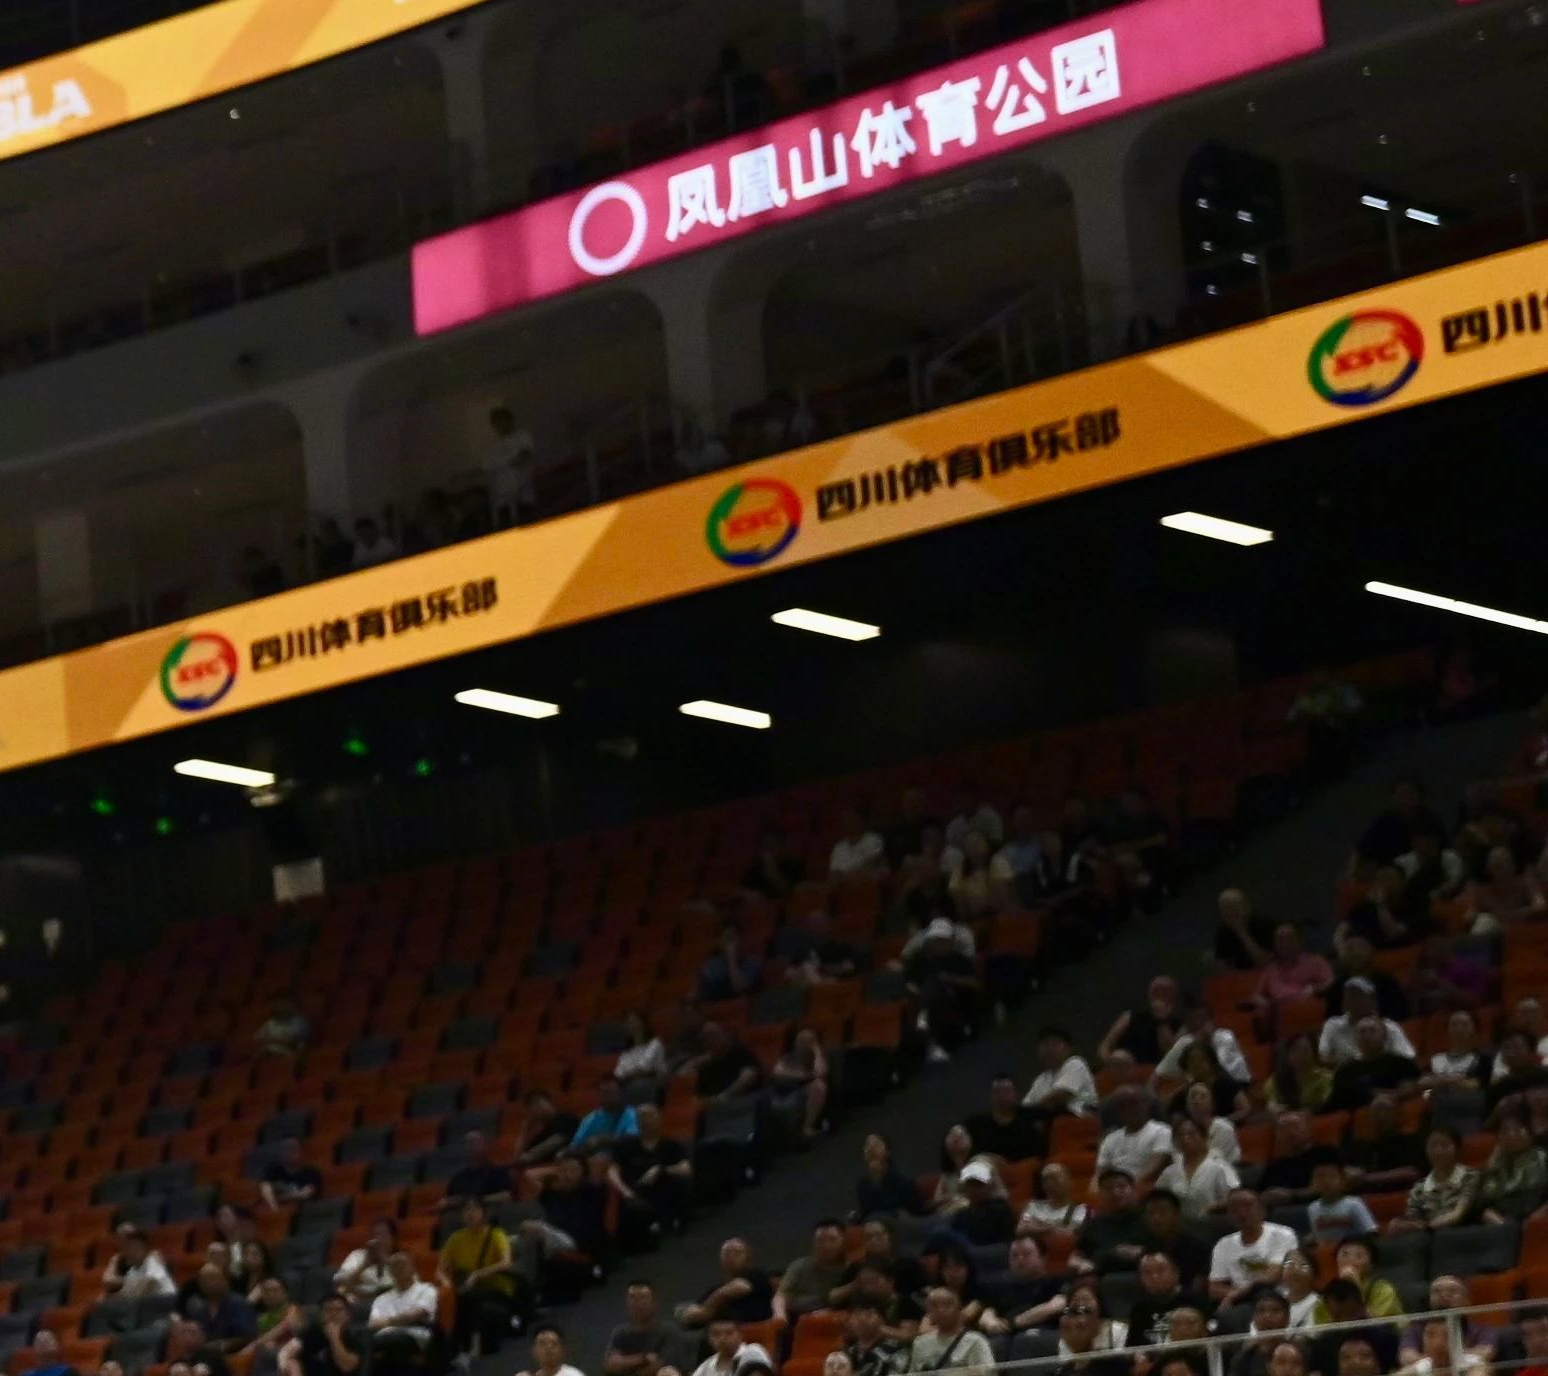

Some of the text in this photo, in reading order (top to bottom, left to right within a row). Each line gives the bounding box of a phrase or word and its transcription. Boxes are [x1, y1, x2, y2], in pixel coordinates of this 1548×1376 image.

[664, 29, 1122, 240] 凤凰山体育公园
[1441, 291, 1548, 353] 四川
[816, 407, 1123, 524] 四川体育俱乐部
[250, 577, 499, 673] 四川体育俱乐部
